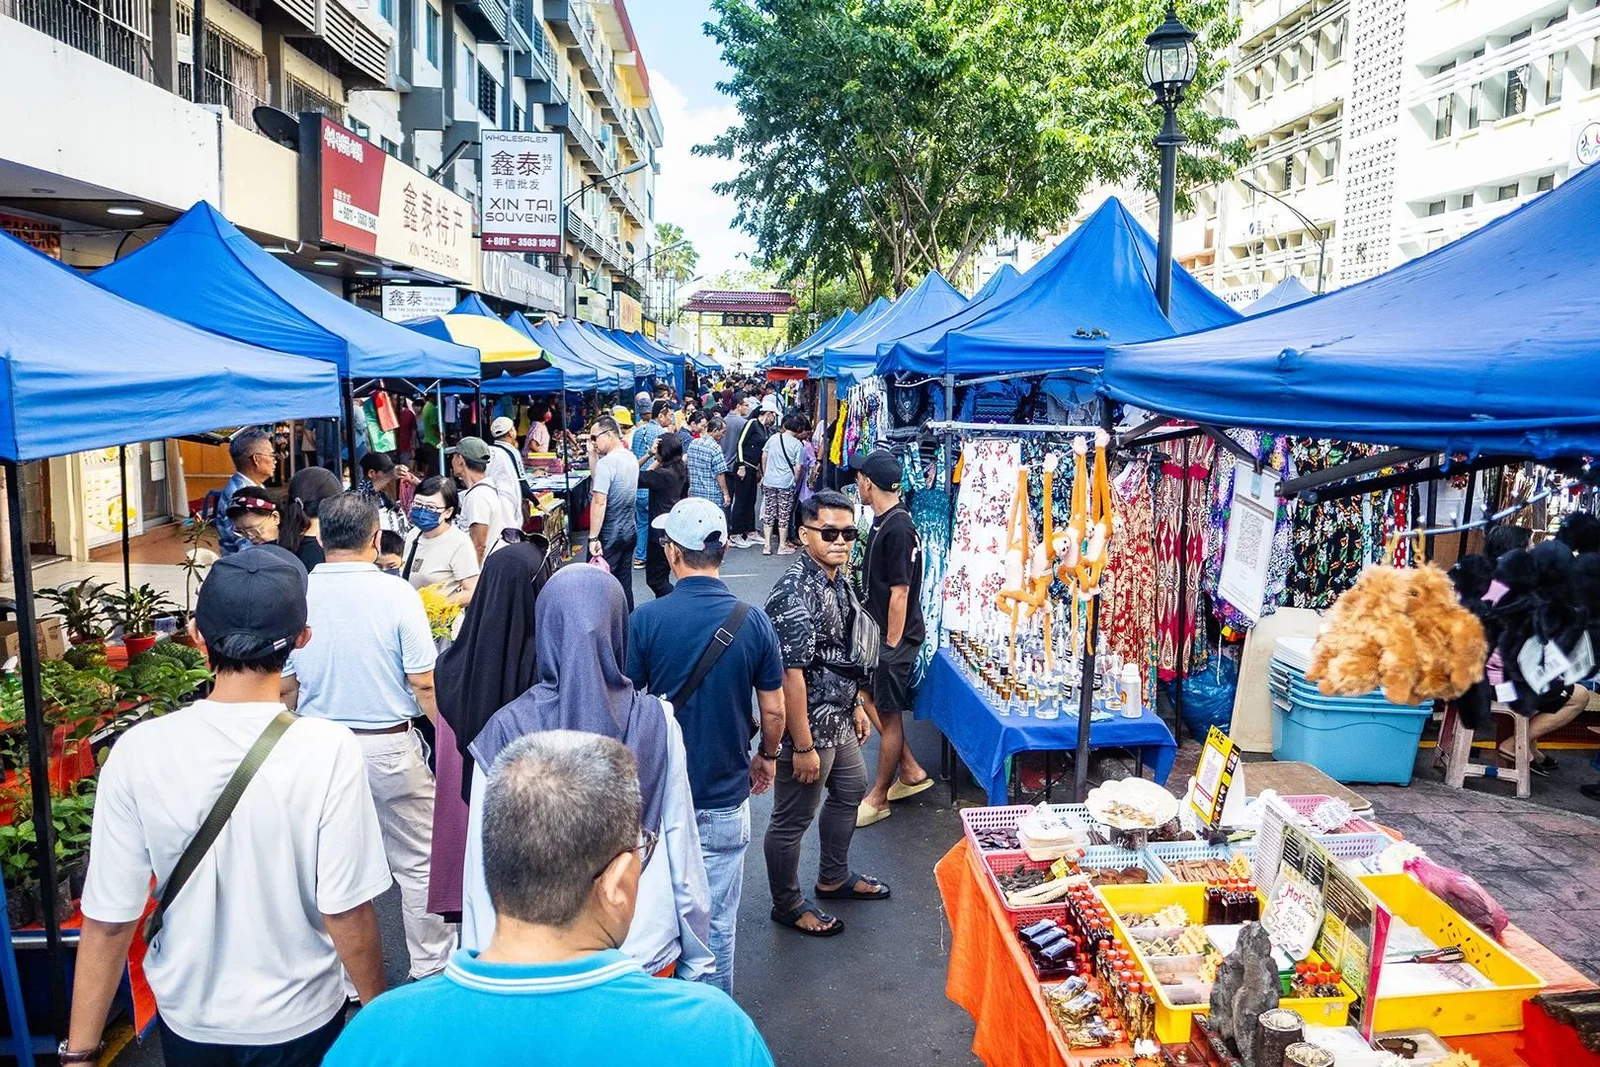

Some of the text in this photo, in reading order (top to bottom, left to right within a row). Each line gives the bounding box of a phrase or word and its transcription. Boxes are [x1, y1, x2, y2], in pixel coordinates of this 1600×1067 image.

[485, 134, 548, 143] WHOLESALER
[491, 150, 541, 177] 鑫泰
[493, 179, 540, 190] 手信批发
[489, 197, 553, 211] XIN TAI
[403, 181, 463, 247] 鑫泰特产
[485, 212, 557, 223] SOUVENIR
